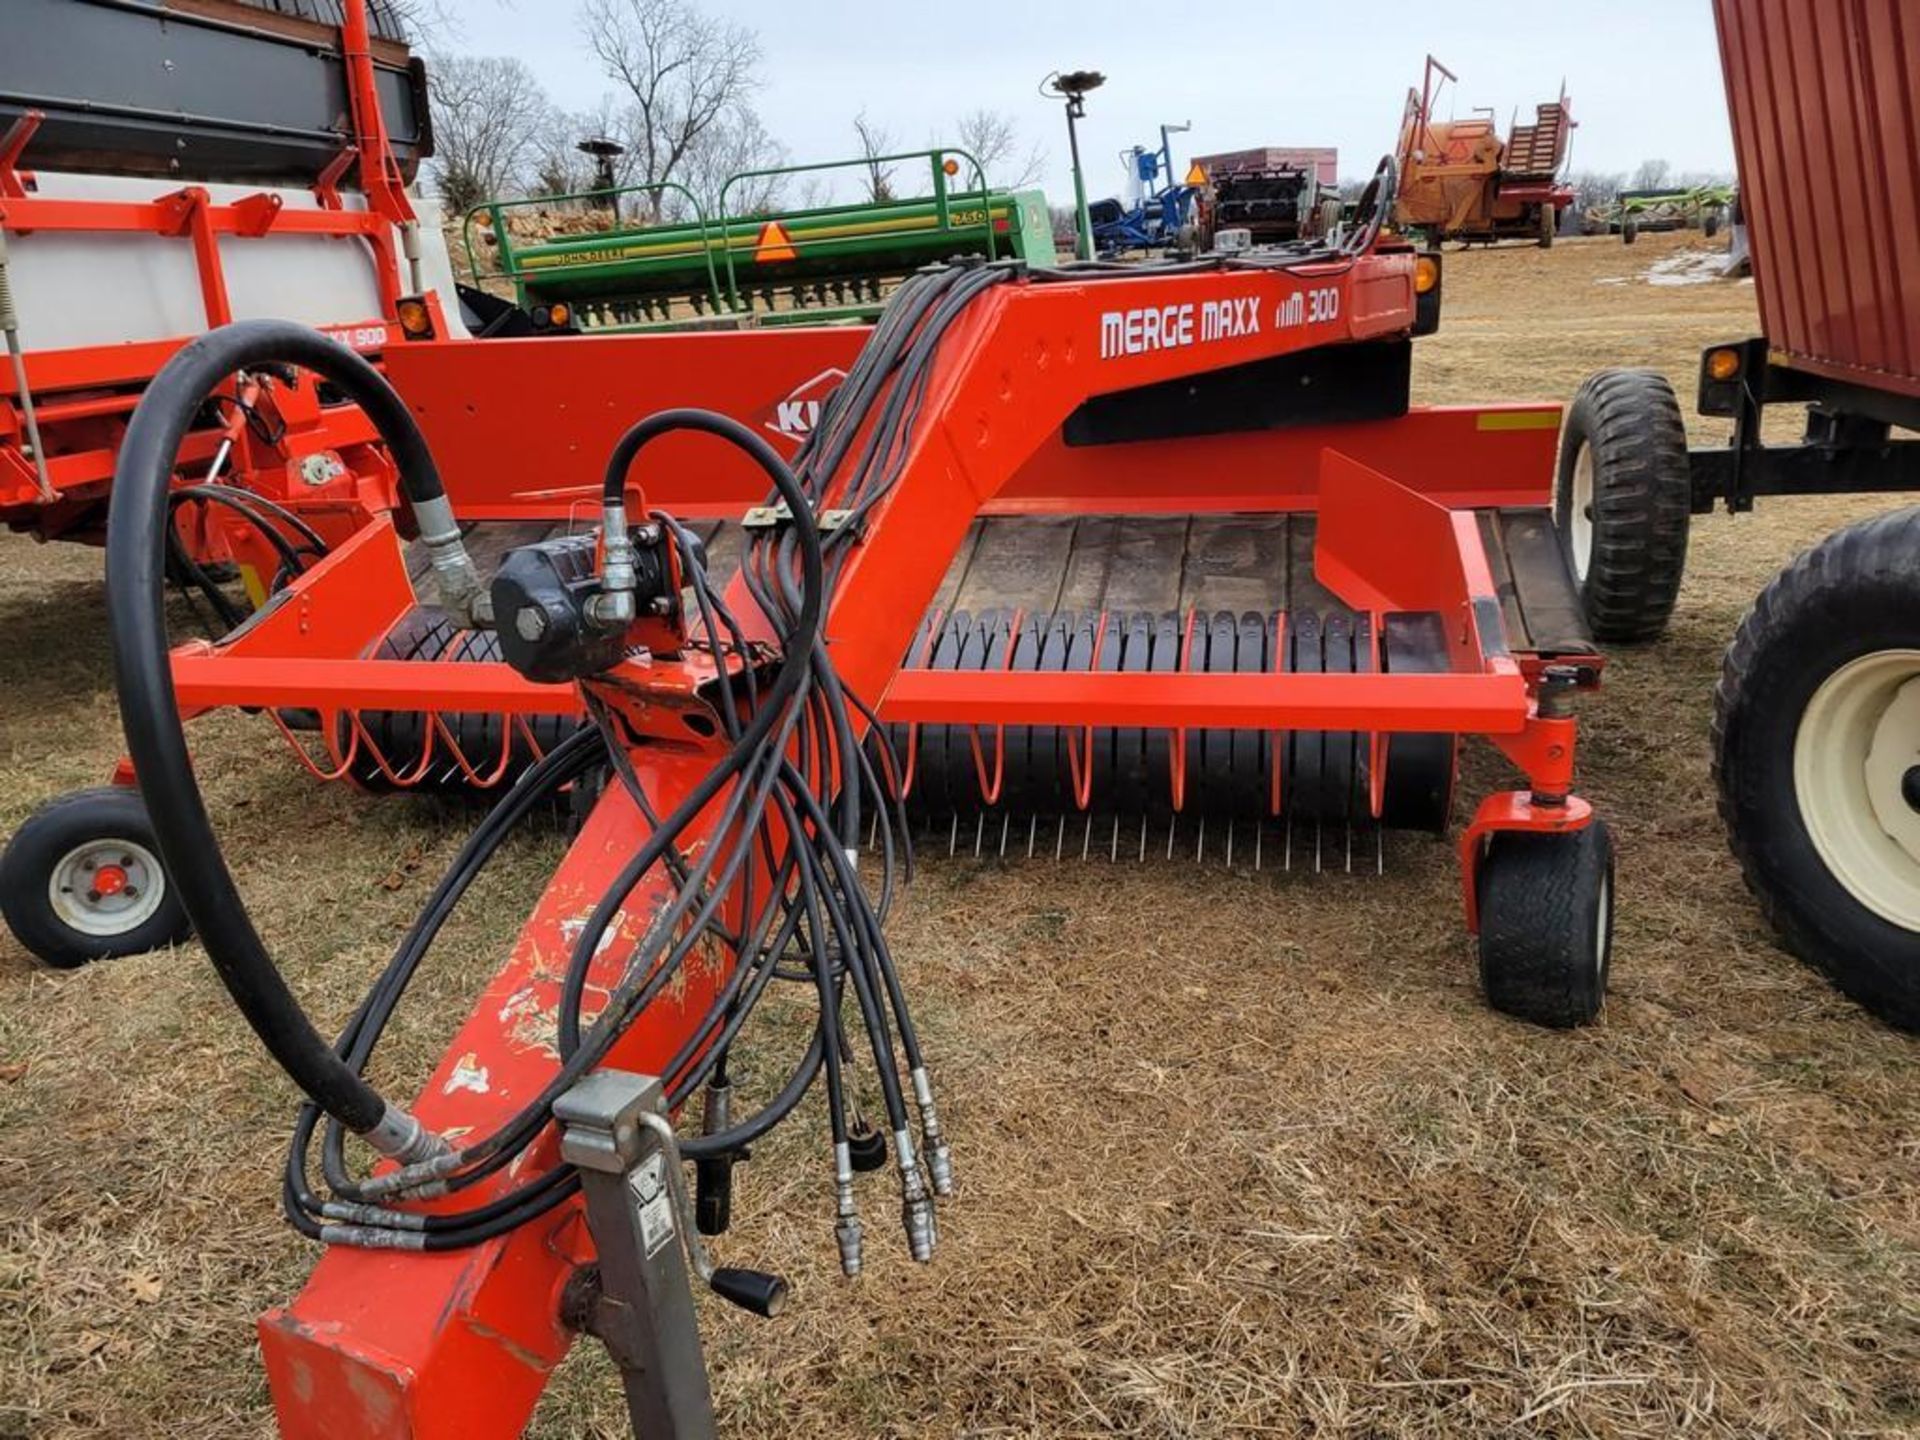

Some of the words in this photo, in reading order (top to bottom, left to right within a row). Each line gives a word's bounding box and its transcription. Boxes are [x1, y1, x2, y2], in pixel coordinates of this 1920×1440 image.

[558, 252, 588, 265] JOHN
[590, 248, 625, 261] DEERE
[1101, 303, 1194, 359] MERGE
[1201, 297, 1261, 342] MAXX
[1308, 287, 1339, 323] 300
[356, 327, 387, 346] 900
